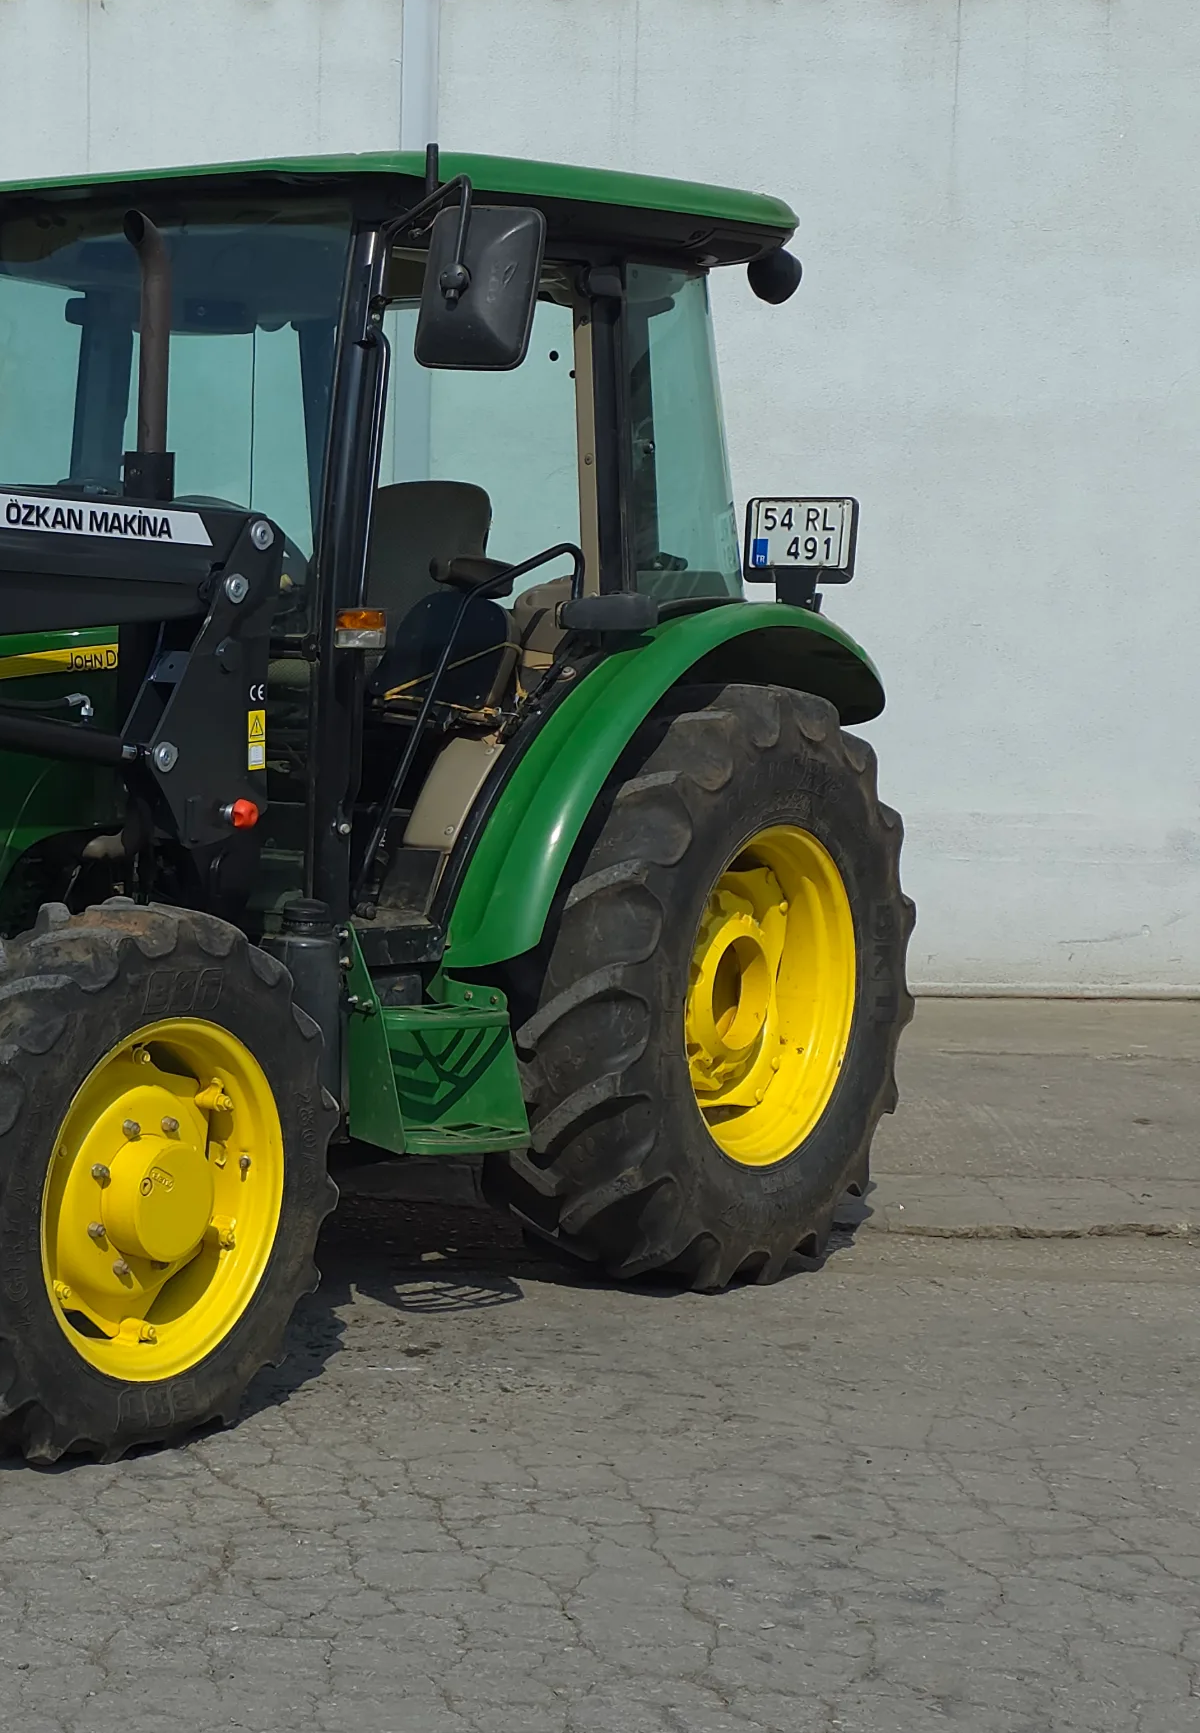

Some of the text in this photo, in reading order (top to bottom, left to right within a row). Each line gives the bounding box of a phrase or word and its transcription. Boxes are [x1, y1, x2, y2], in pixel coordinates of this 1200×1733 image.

[5, 498, 172, 539] ÖZKAN MAKİNA
[764, 508, 835, 531] 54 RL
[756, 554, 766, 564] TR
[786, 536, 832, 560] 491
[66, 652, 104, 670] JOHN
